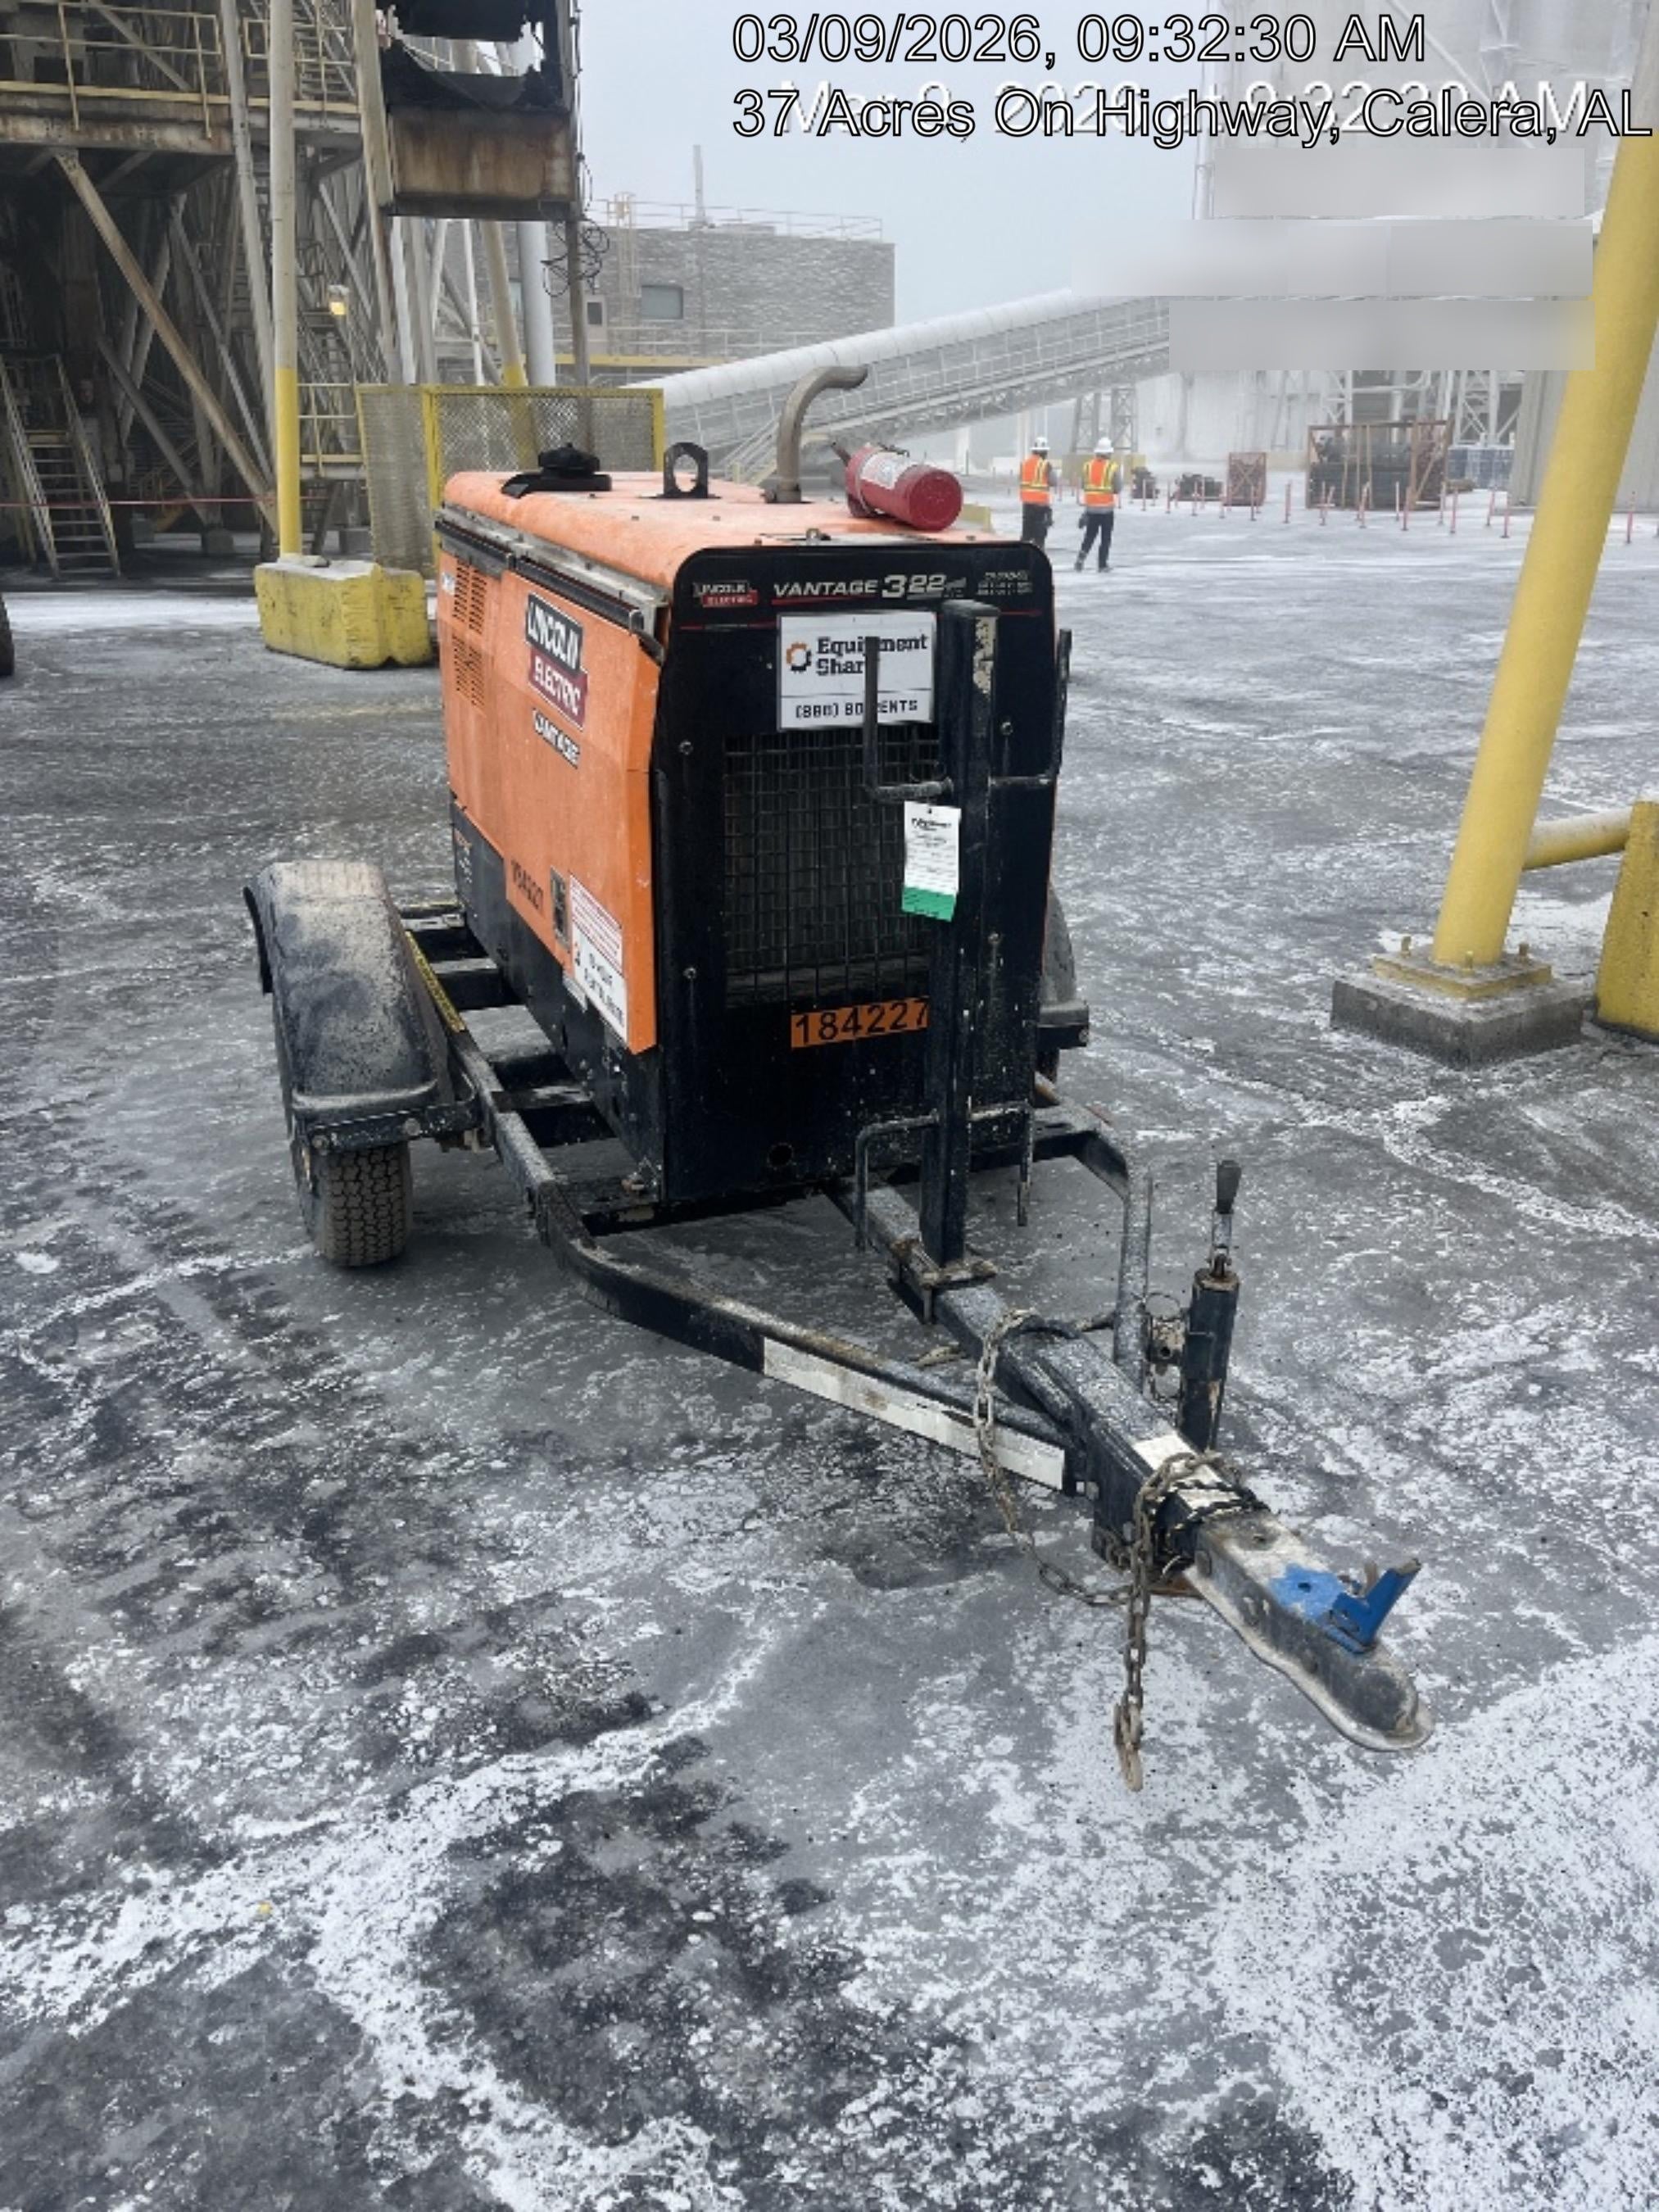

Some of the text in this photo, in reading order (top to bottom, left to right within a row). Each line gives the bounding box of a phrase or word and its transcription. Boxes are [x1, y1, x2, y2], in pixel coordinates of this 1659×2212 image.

[773, 579, 879, 597] VANTAGE
[882, 573, 946, 598] 322
[528, 601, 579, 670] LINCOLN
[816, 633, 928, 657] Equiment
[816, 658, 867, 677] Shar
[795, 1000, 929, 1045] 184227
